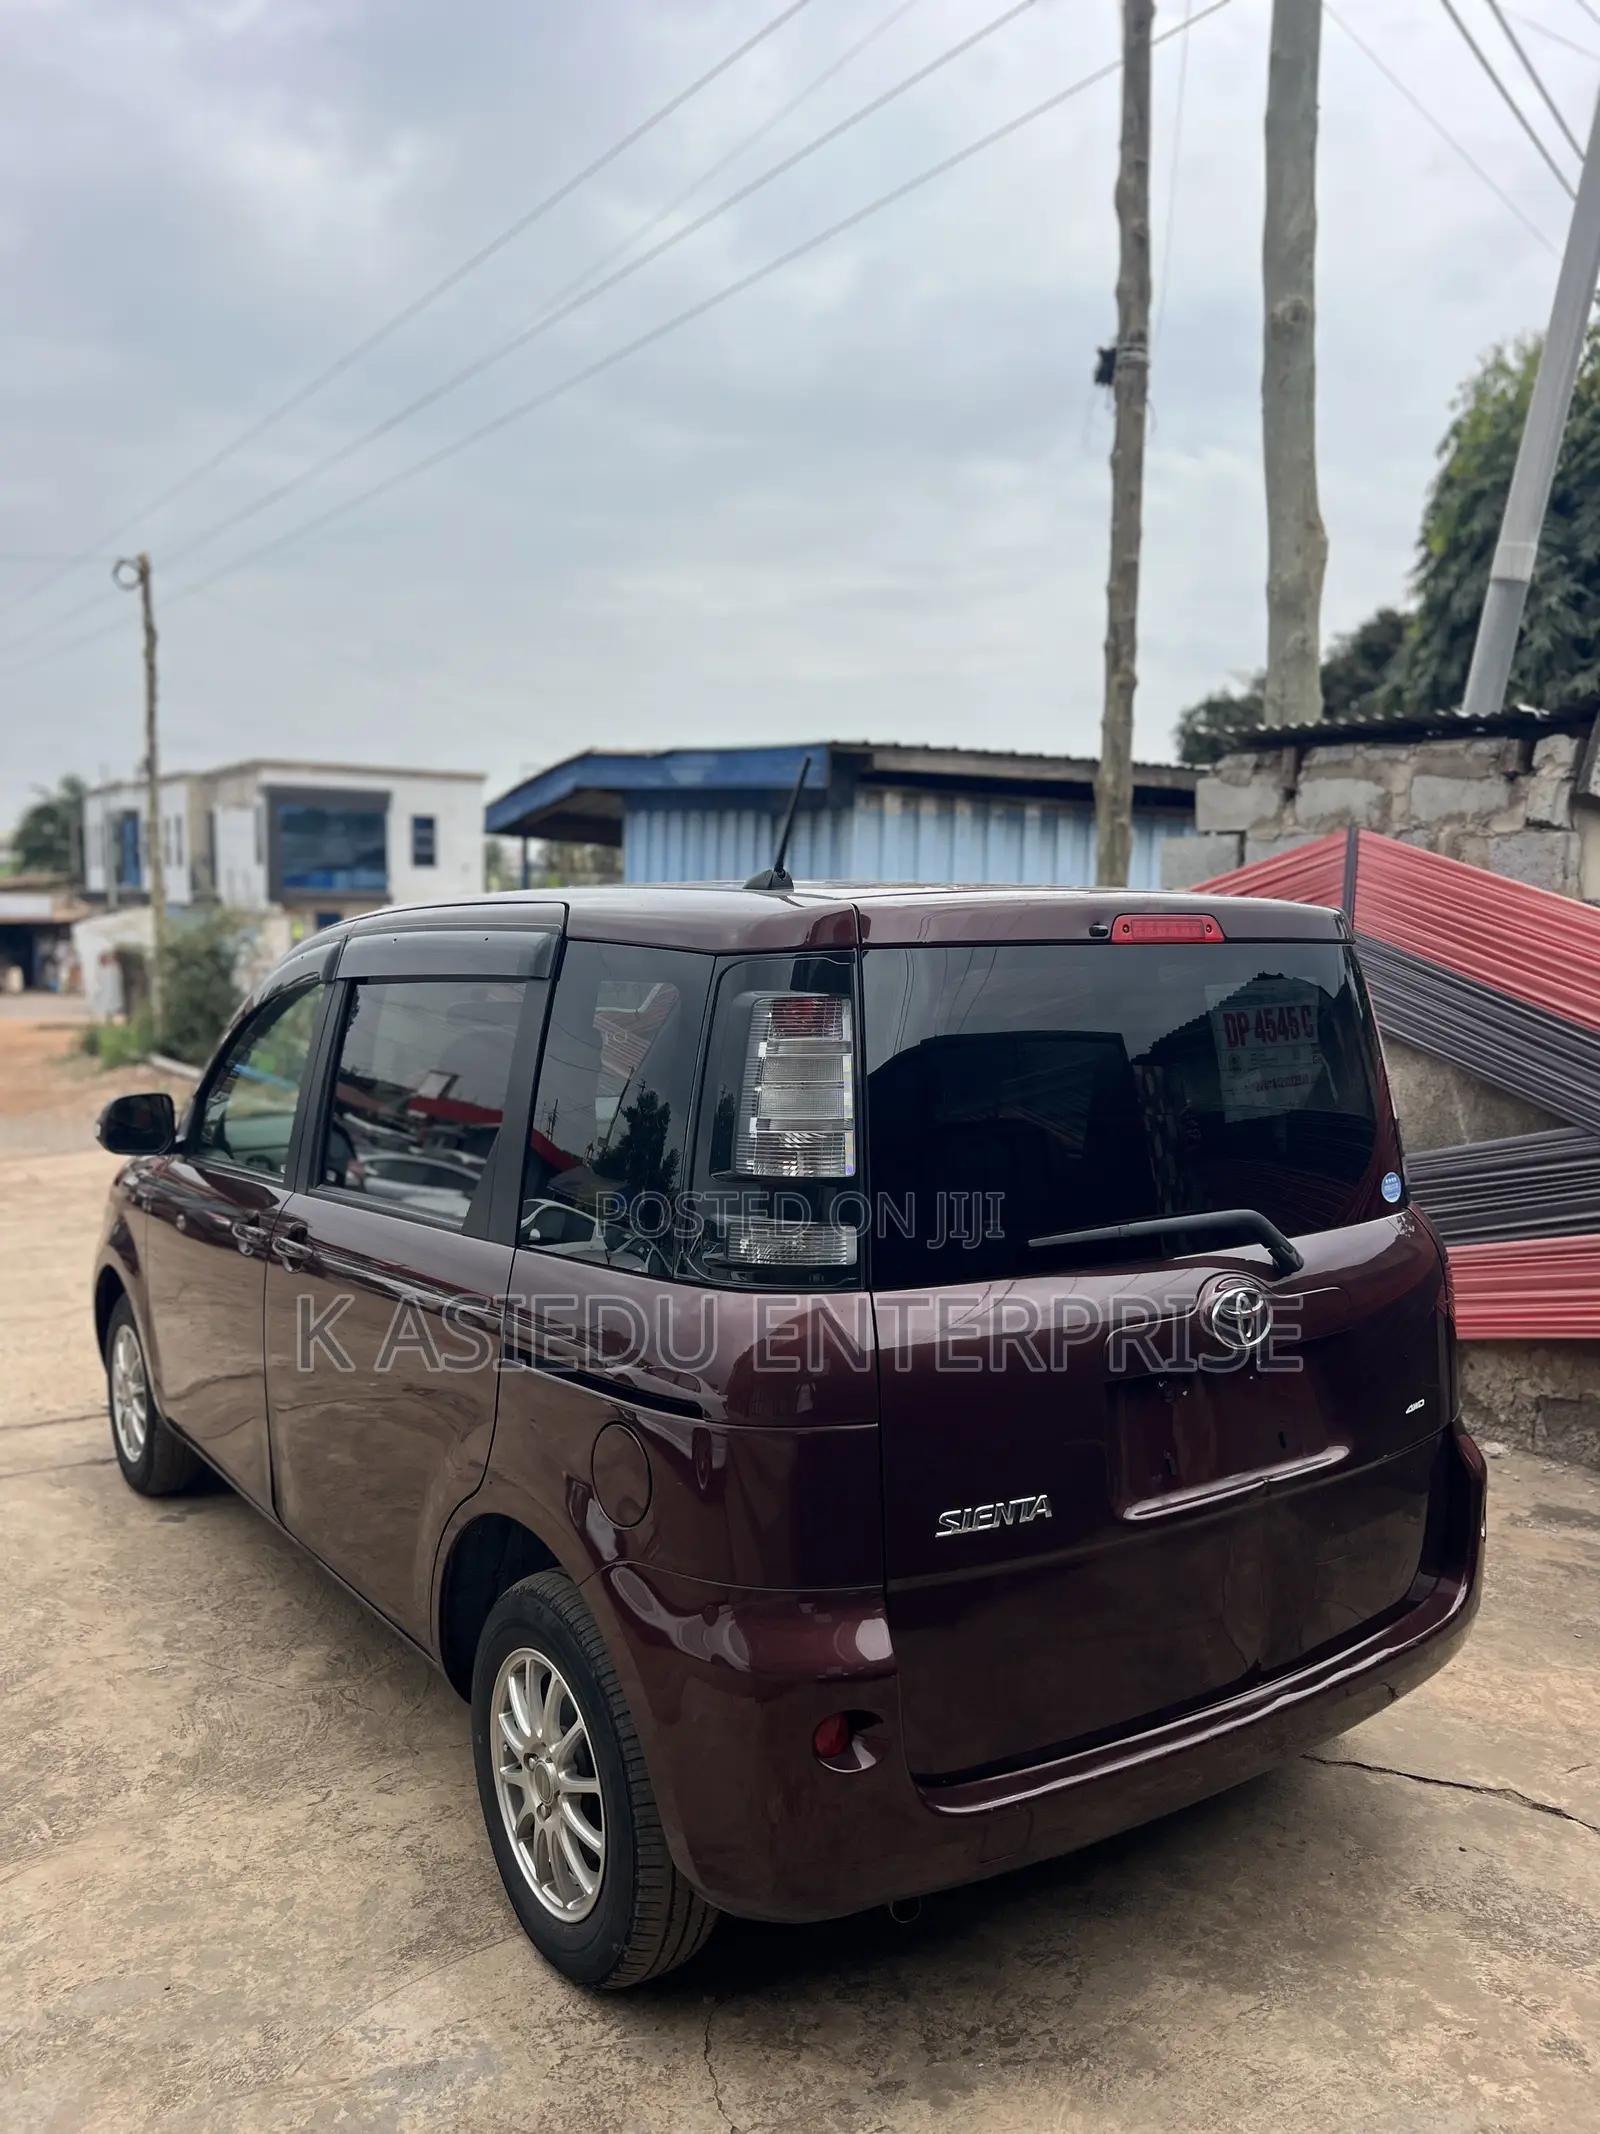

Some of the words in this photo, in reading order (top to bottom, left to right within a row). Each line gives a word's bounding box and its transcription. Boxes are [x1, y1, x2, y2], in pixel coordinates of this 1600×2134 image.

[1223, 1011, 1250, 1048] DP
[1255, 1006, 1300, 1044] 4545
[1301, 1004, 1315, 1038] C
[935, 1494, 1052, 1538] SIENTA
